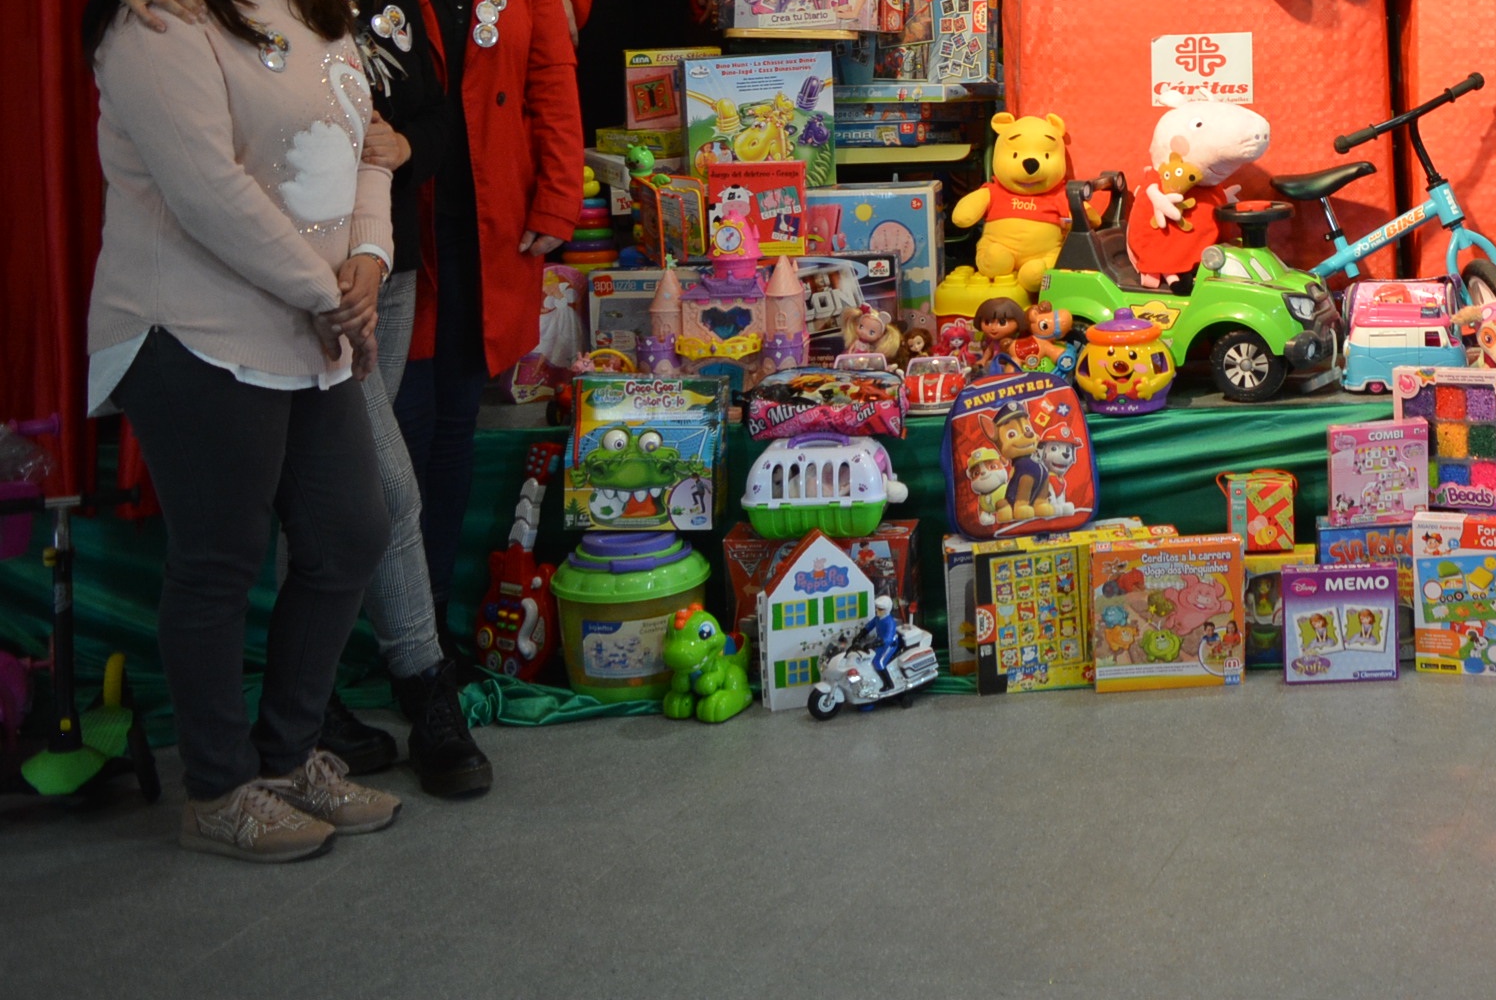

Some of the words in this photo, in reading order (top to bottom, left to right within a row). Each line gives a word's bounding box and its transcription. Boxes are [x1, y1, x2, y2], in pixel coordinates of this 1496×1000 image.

[771, 14, 790, 22] Crea
[793, 13, 802, 21] tu
[804, 11, 828, 20] Diario
[1011, 198, 1037, 211] Pooh
[1385, 205, 1425, 239] BIKE
[964, 391, 996, 409] PAW
[998, 378, 1054, 399] PATROL
[857, 402, 876, 422] on!
[750, 418, 767, 435] Be
[1368, 430, 1404, 441] COMBI
[1447, 485, 1495, 505] Beads
[1141, 551, 1179, 563] Cerditos
[1189, 550, 1197, 561] la
[1198, 551, 1231, 561] carrera
[1145, 566, 1166, 578] Jogo
[1167, 564, 1181, 575] dos
[1184, 562, 1228, 577] Porquinhos
[795, 573, 828, 594] Peppa
[829, 569, 846, 587] Pig
[1325, 576, 1389, 591] MEMO
